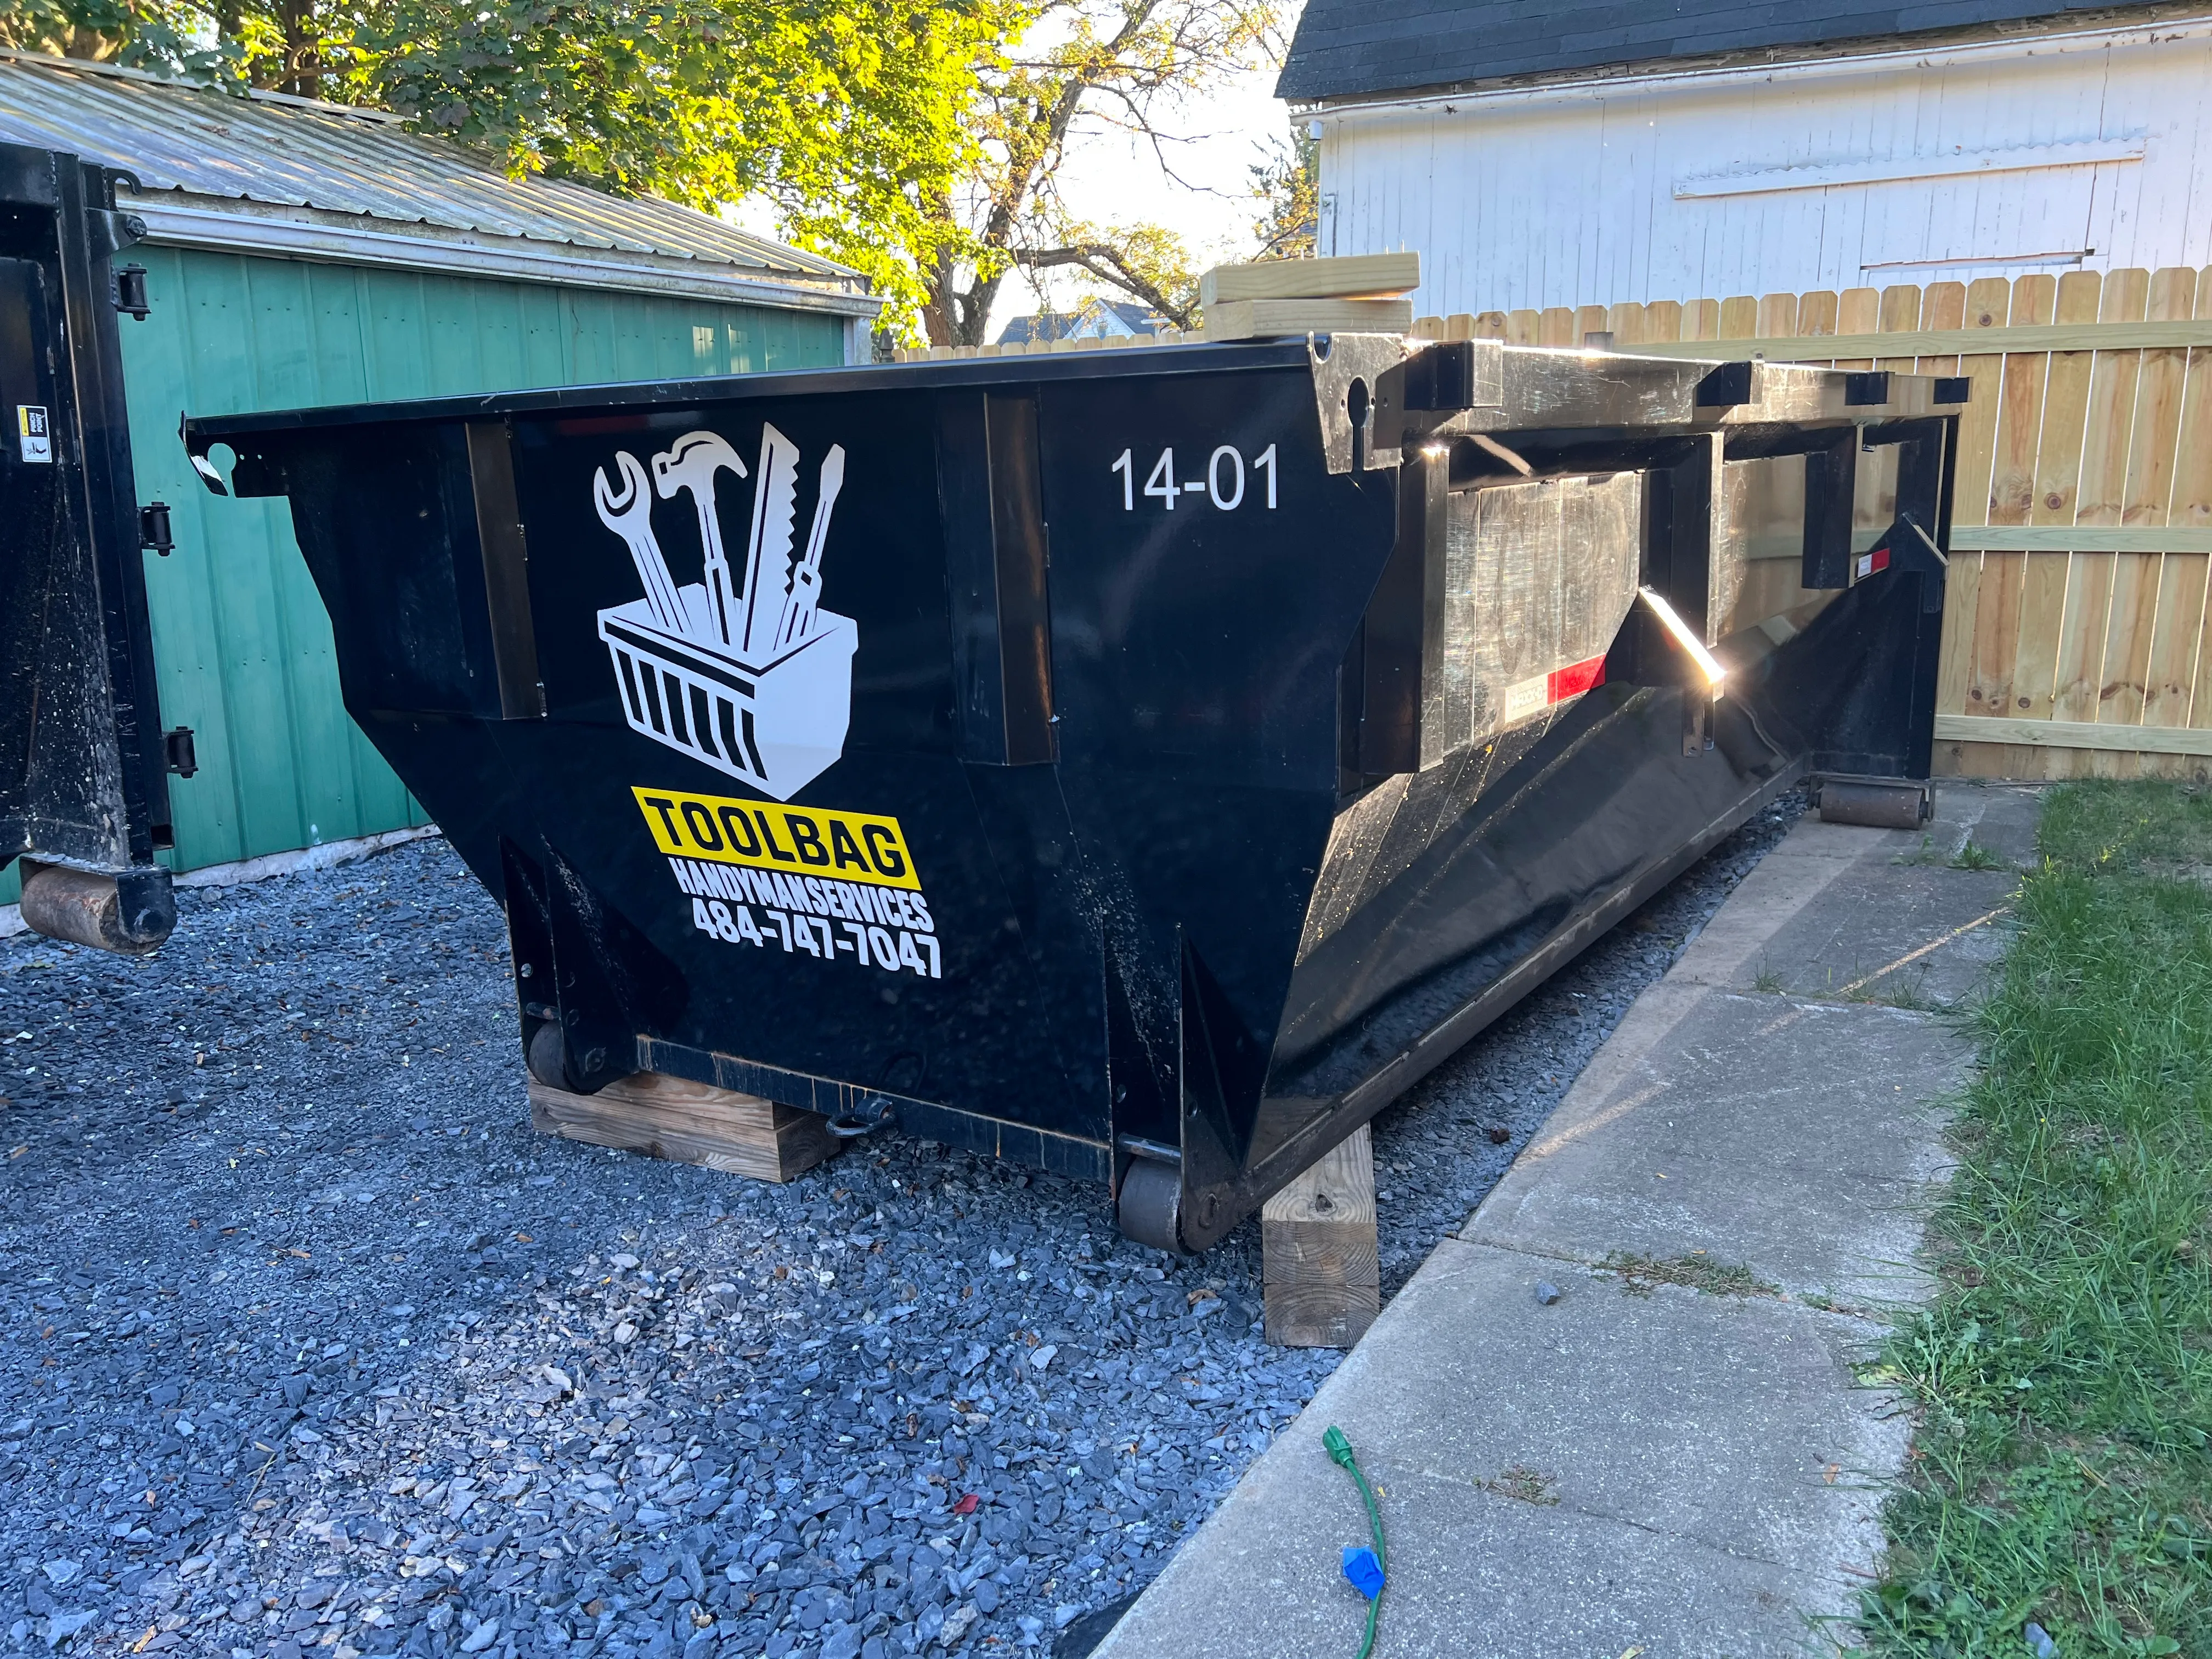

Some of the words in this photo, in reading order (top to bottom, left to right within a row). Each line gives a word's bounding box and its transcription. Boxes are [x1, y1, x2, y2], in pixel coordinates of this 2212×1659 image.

[1112, 443, 1277, 510] 14-01
[644, 797, 906, 878] TOOLBAG
[668, 857, 934, 933] HANDYMANSERVICES
[692, 898, 941, 979] 484-747-7047
